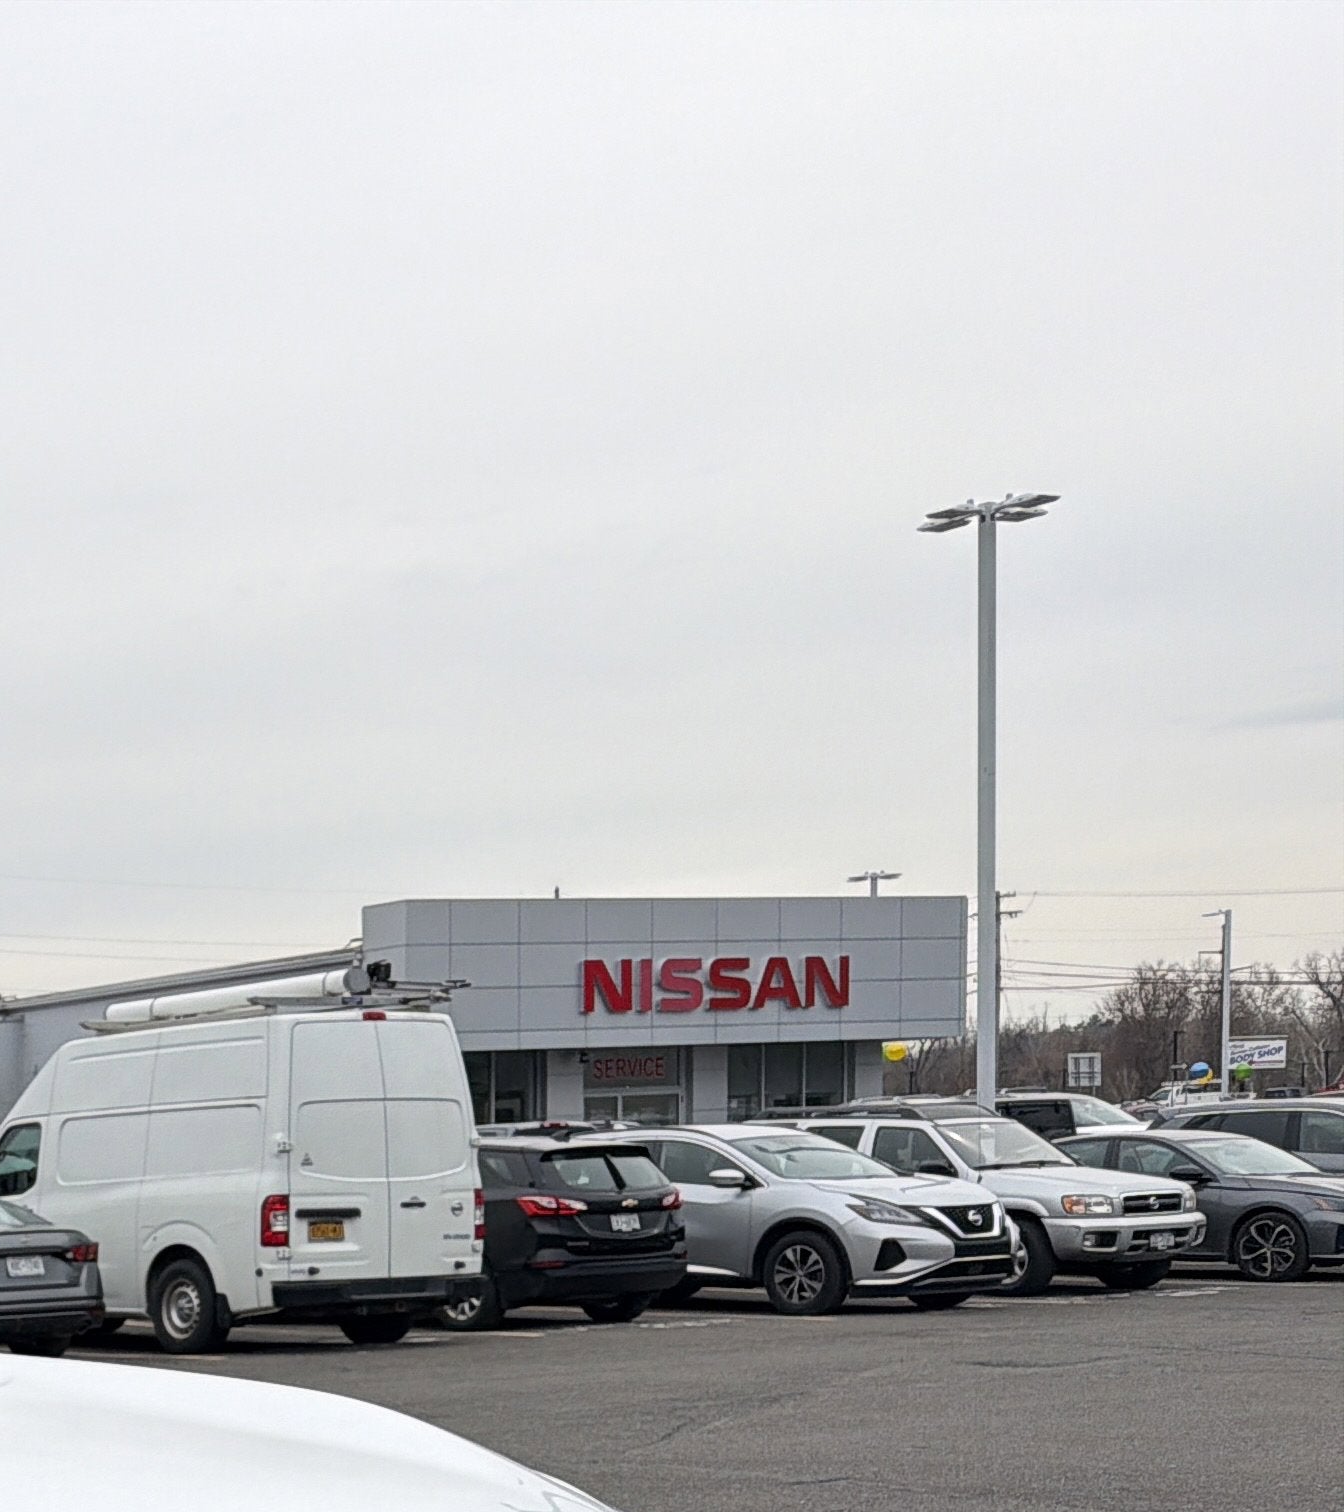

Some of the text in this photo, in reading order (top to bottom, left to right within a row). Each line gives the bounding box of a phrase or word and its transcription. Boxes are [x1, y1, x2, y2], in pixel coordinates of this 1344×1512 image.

[581, 955, 850, 1014] NISSAN
[1230, 1052, 1256, 1065] BODY
[1257, 1046, 1283, 1059] SHOP
[593, 1056, 664, 1080] SERVICE
